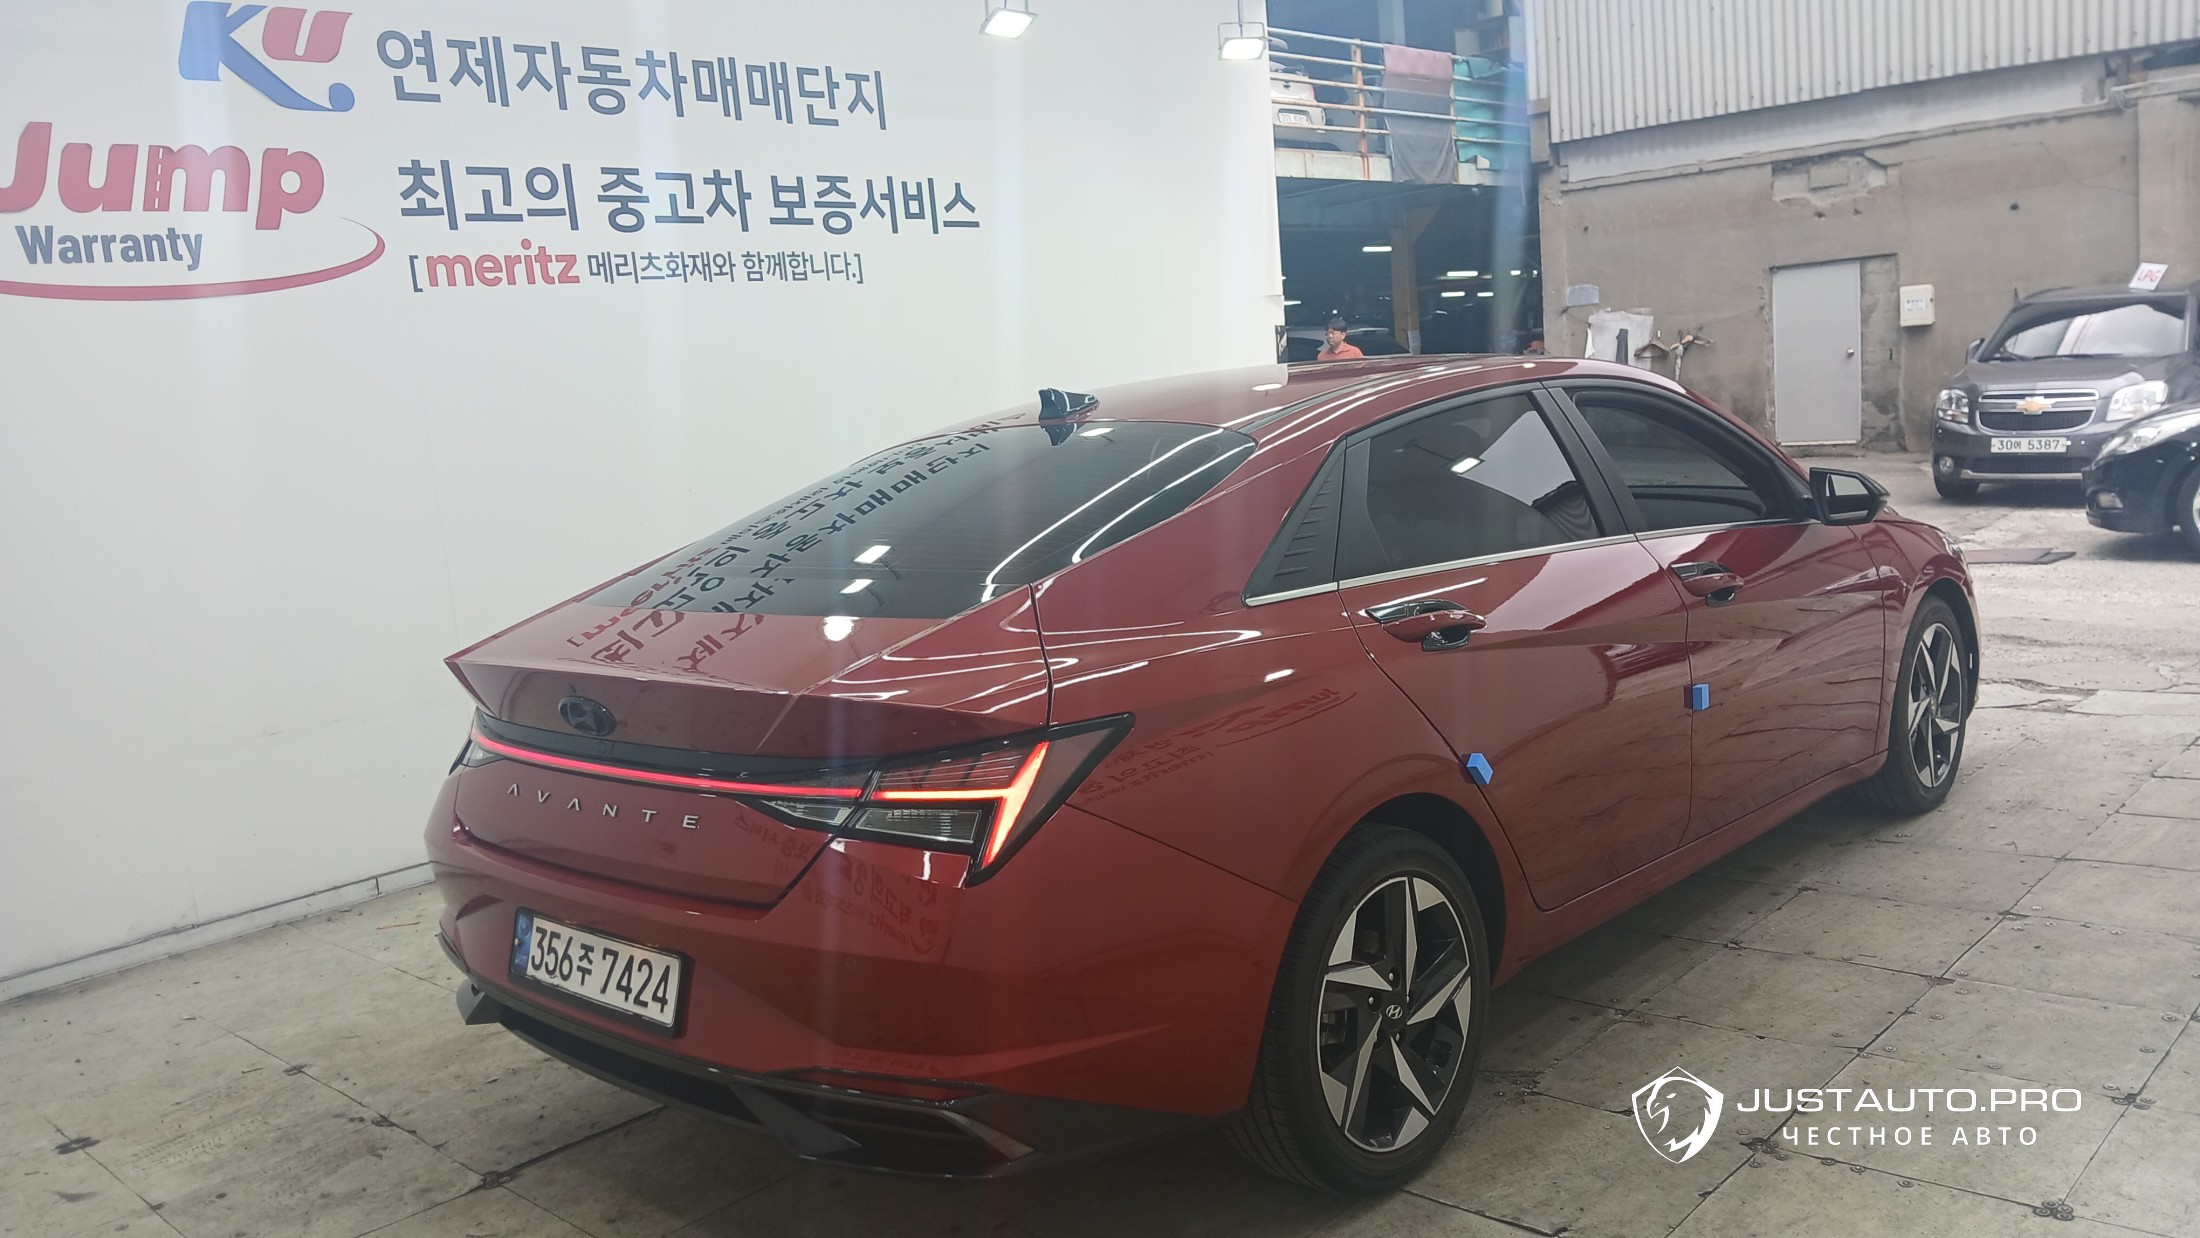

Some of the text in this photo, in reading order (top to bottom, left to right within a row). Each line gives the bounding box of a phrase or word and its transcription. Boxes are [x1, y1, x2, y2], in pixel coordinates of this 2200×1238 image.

[376, 29, 888, 130] 연제자동차매매단지
[0, 121, 325, 230] Jump
[398, 159, 981, 235] 최고의 중고차 보증서비스
[15, 225, 202, 271] Warranty
[587, 251, 737, 284] 메리츠화재와
[2136, 269, 2161, 282] LPG
[507, 783, 700, 829] AVANTE
[530, 926, 671, 1013] 356주 7424
